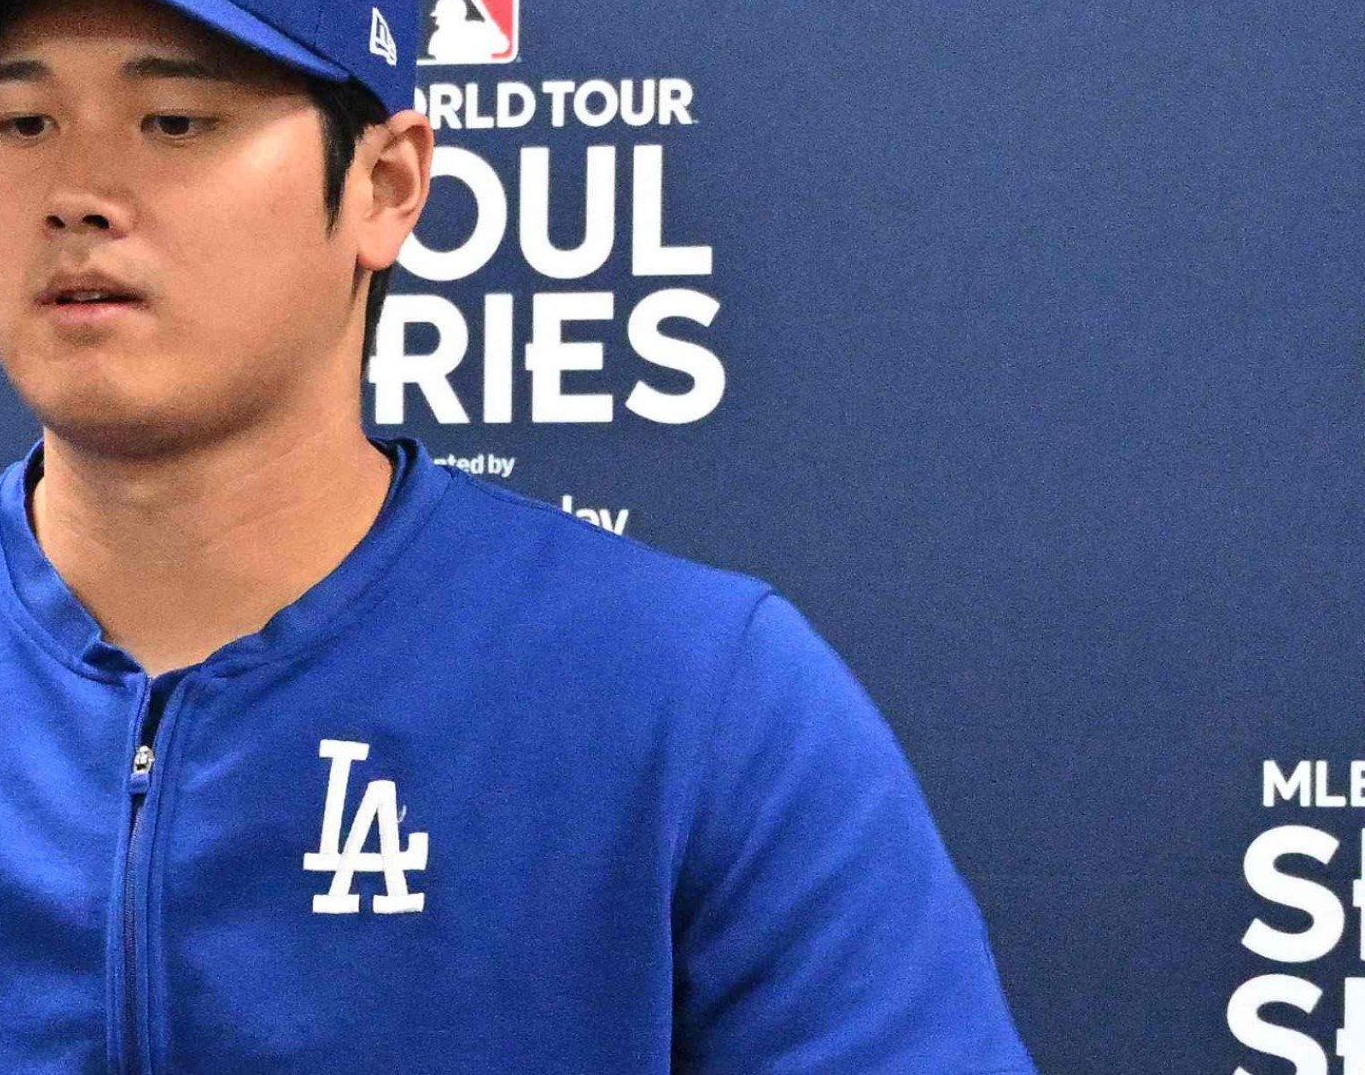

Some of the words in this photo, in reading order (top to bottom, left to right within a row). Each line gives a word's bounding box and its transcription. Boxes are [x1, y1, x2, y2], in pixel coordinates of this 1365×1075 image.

[414, 81, 536, 129] RLD
[542, 78, 693, 126] TOUR
[395, 144, 713, 282] OUL
[369, 288, 726, 425] RIES
[488, 454, 515, 477] by
[303, 739, 429, 915] LA
